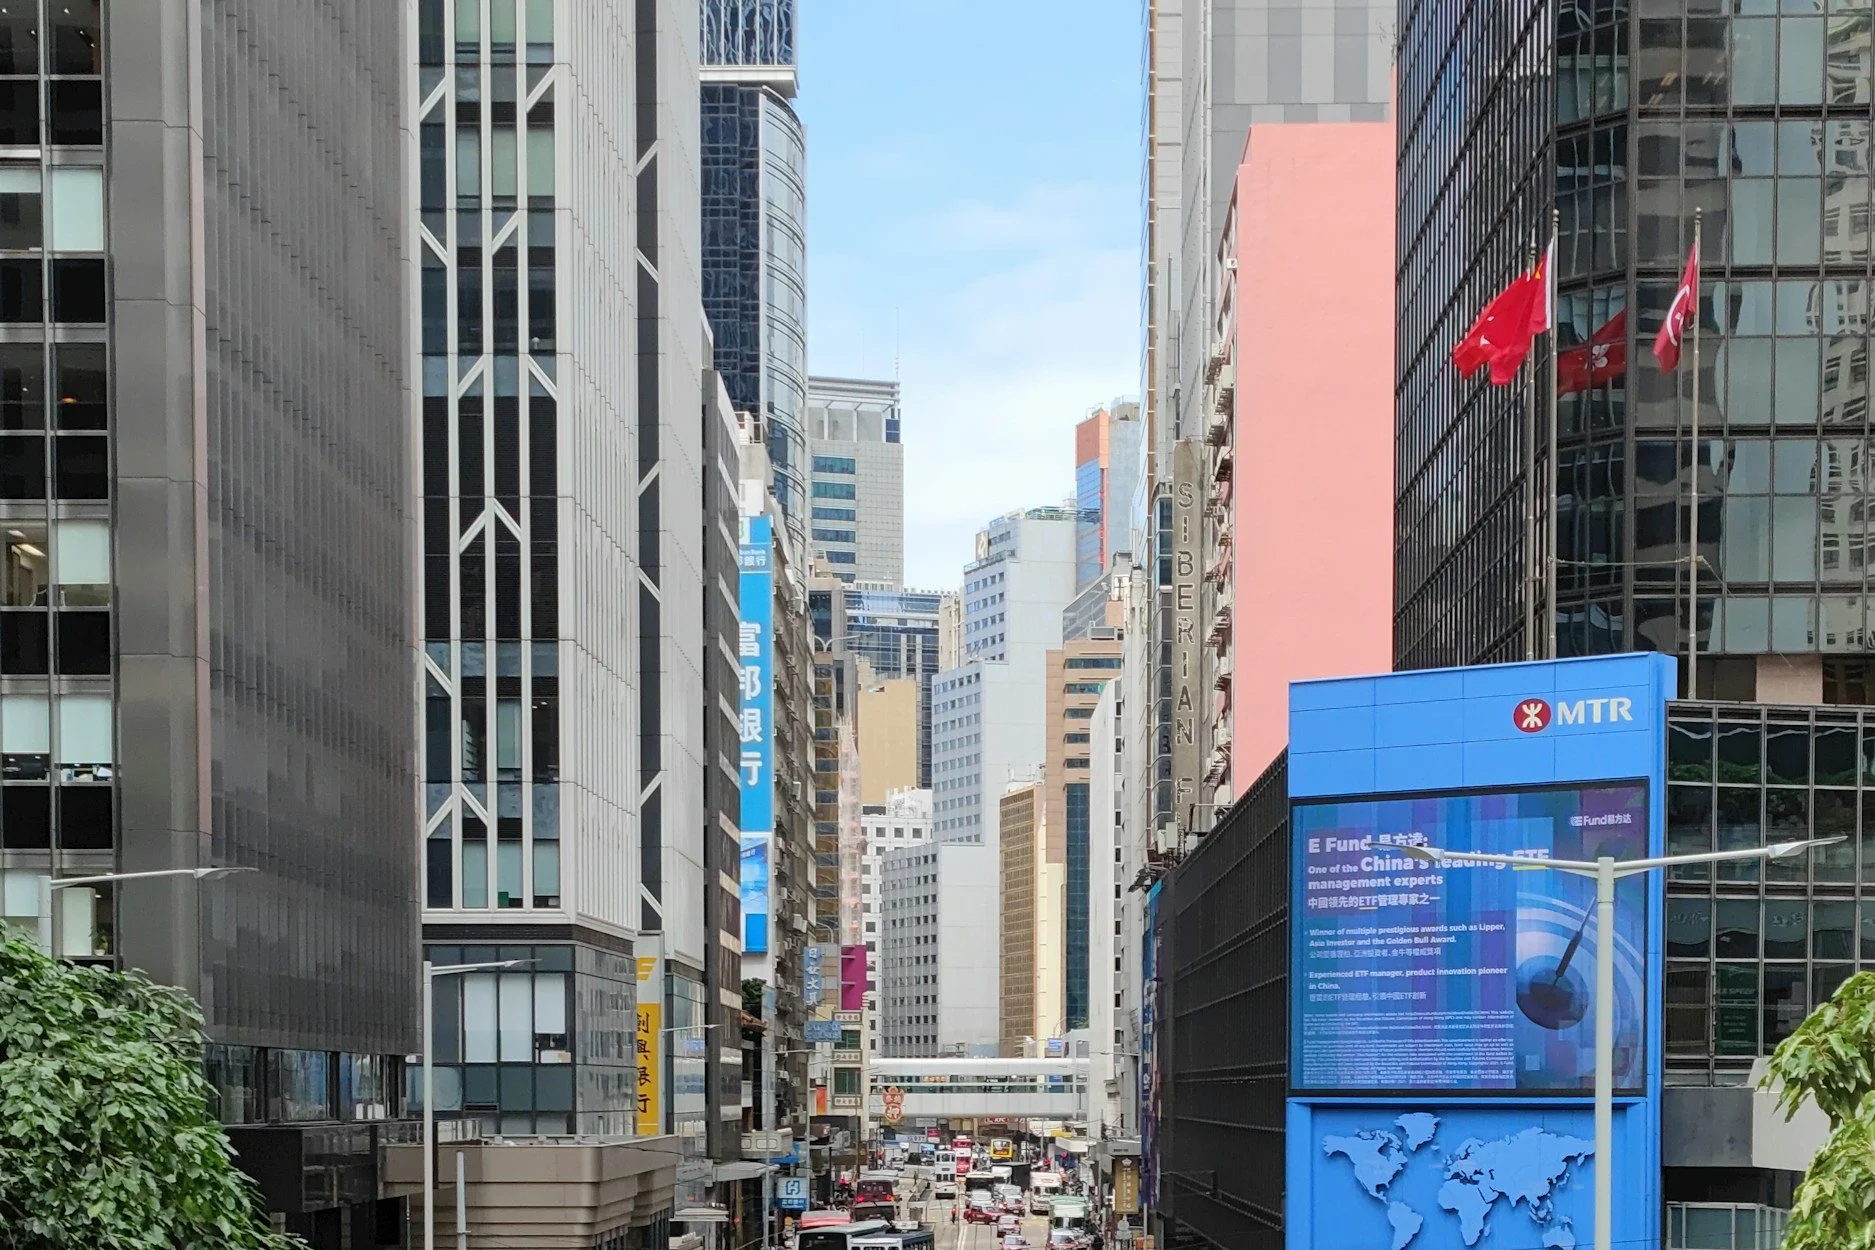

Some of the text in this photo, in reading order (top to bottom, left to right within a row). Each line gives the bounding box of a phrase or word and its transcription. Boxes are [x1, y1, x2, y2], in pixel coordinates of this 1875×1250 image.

[1175, 482, 1195, 746] SIBERIAN
[1557, 696, 1633, 726] MTR
[1308, 838, 1320, 853] E
[1325, 834, 1372, 852] Fund
[1308, 865, 1327, 875] One
[1329, 863, 1342, 874] of
[1344, 863, 1359, 873] the
[1360, 855, 1429, 873] China's
[1308, 874, 1444, 891] management experts
[1309, 928, 1336, 936] Winner
[1337, 927, 1345, 936] of
[1346, 926, 1376, 936] multiple
[1378, 925, 1419, 936] prestigious
[1421, 924, 1448, 933] awards
[1449, 923, 1467, 932] such
[1469, 924, 1478, 932] as
[1309, 939, 1325, 947] Asia
[1357, 938, 1370, 946] and
[1372, 937, 1384, 945] the
[1414, 935, 1429, 944] Bull
[1309, 971, 1353, 980] Experienced
[1355, 969, 1369, 978] ETF
[1405, 967, 1435, 978] product
[1436, 967, 1477, 976] innovation
[1478, 966, 1508, 977] pioneer
[1308, 982, 1317, 990] in
